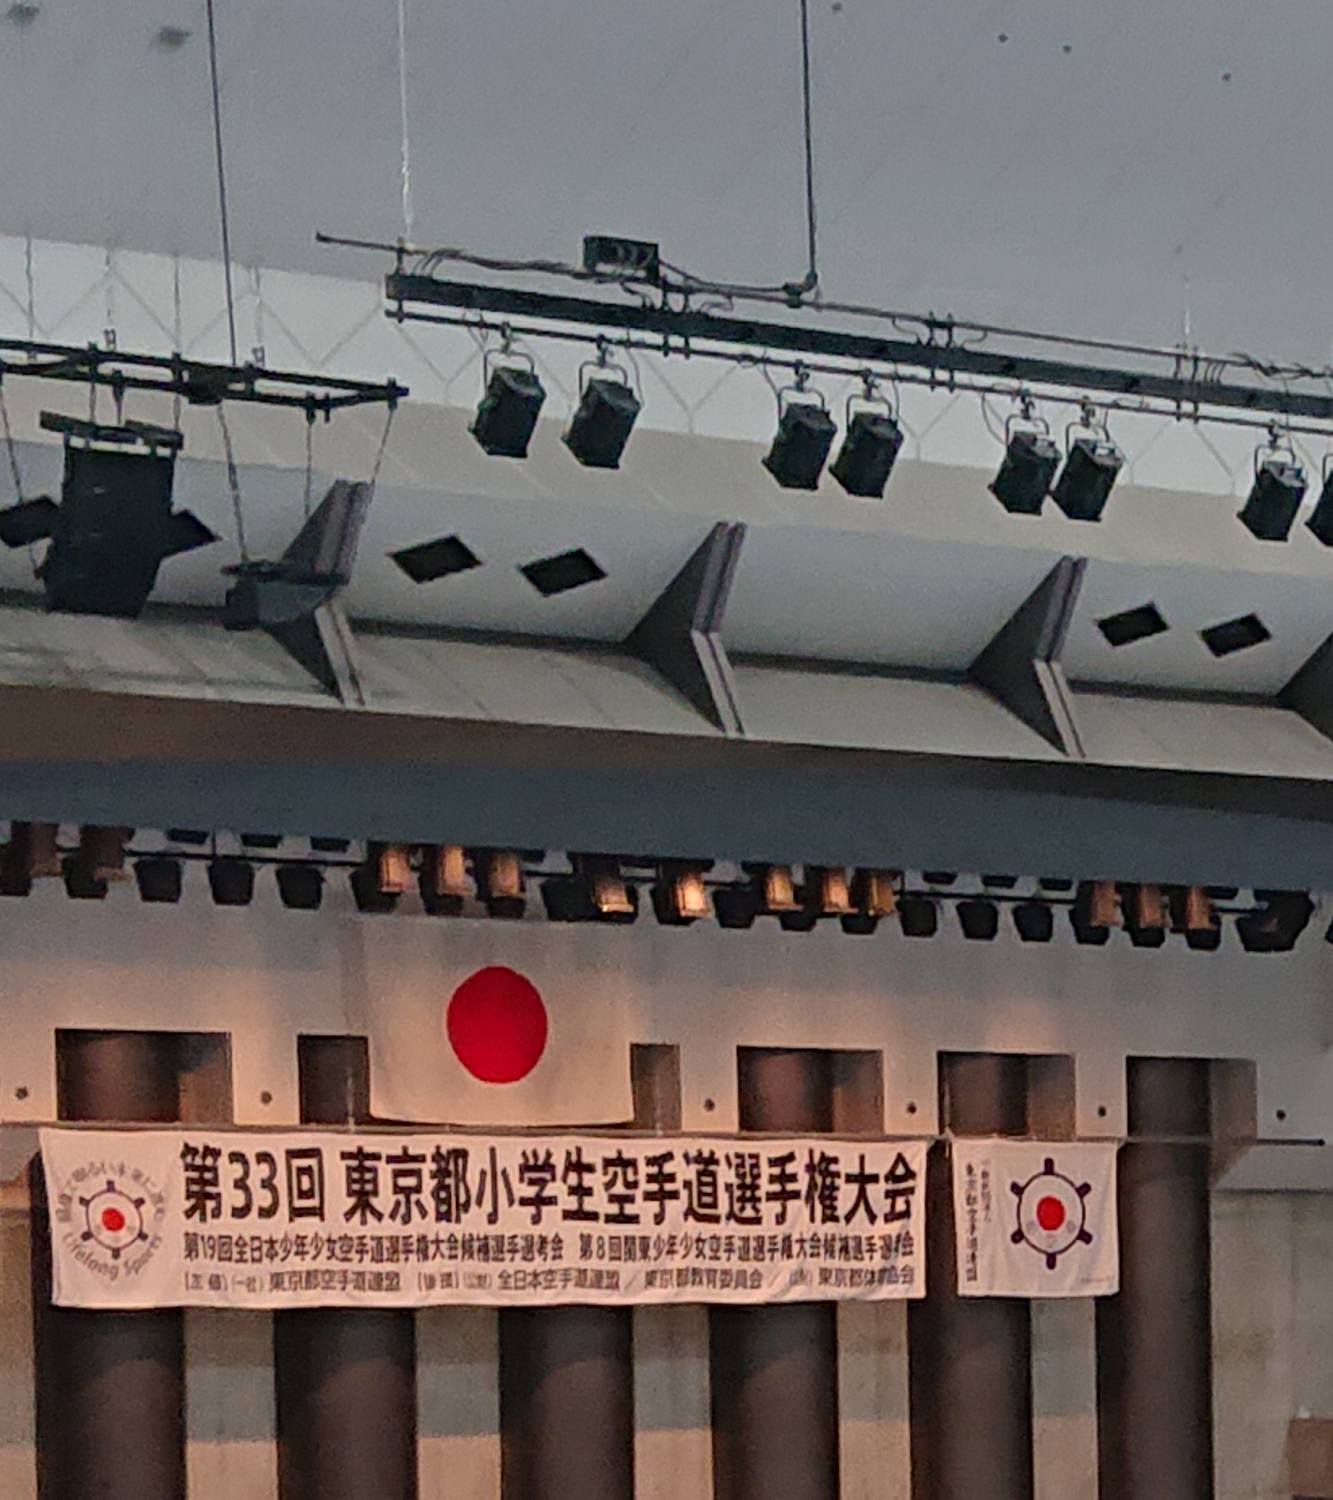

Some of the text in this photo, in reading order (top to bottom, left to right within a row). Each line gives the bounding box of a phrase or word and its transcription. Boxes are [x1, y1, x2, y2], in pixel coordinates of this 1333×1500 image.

[181, 1141, 325, 1226] 第33回
[339, 1146, 918, 1227] 東京都小学生空手道選手権大会
